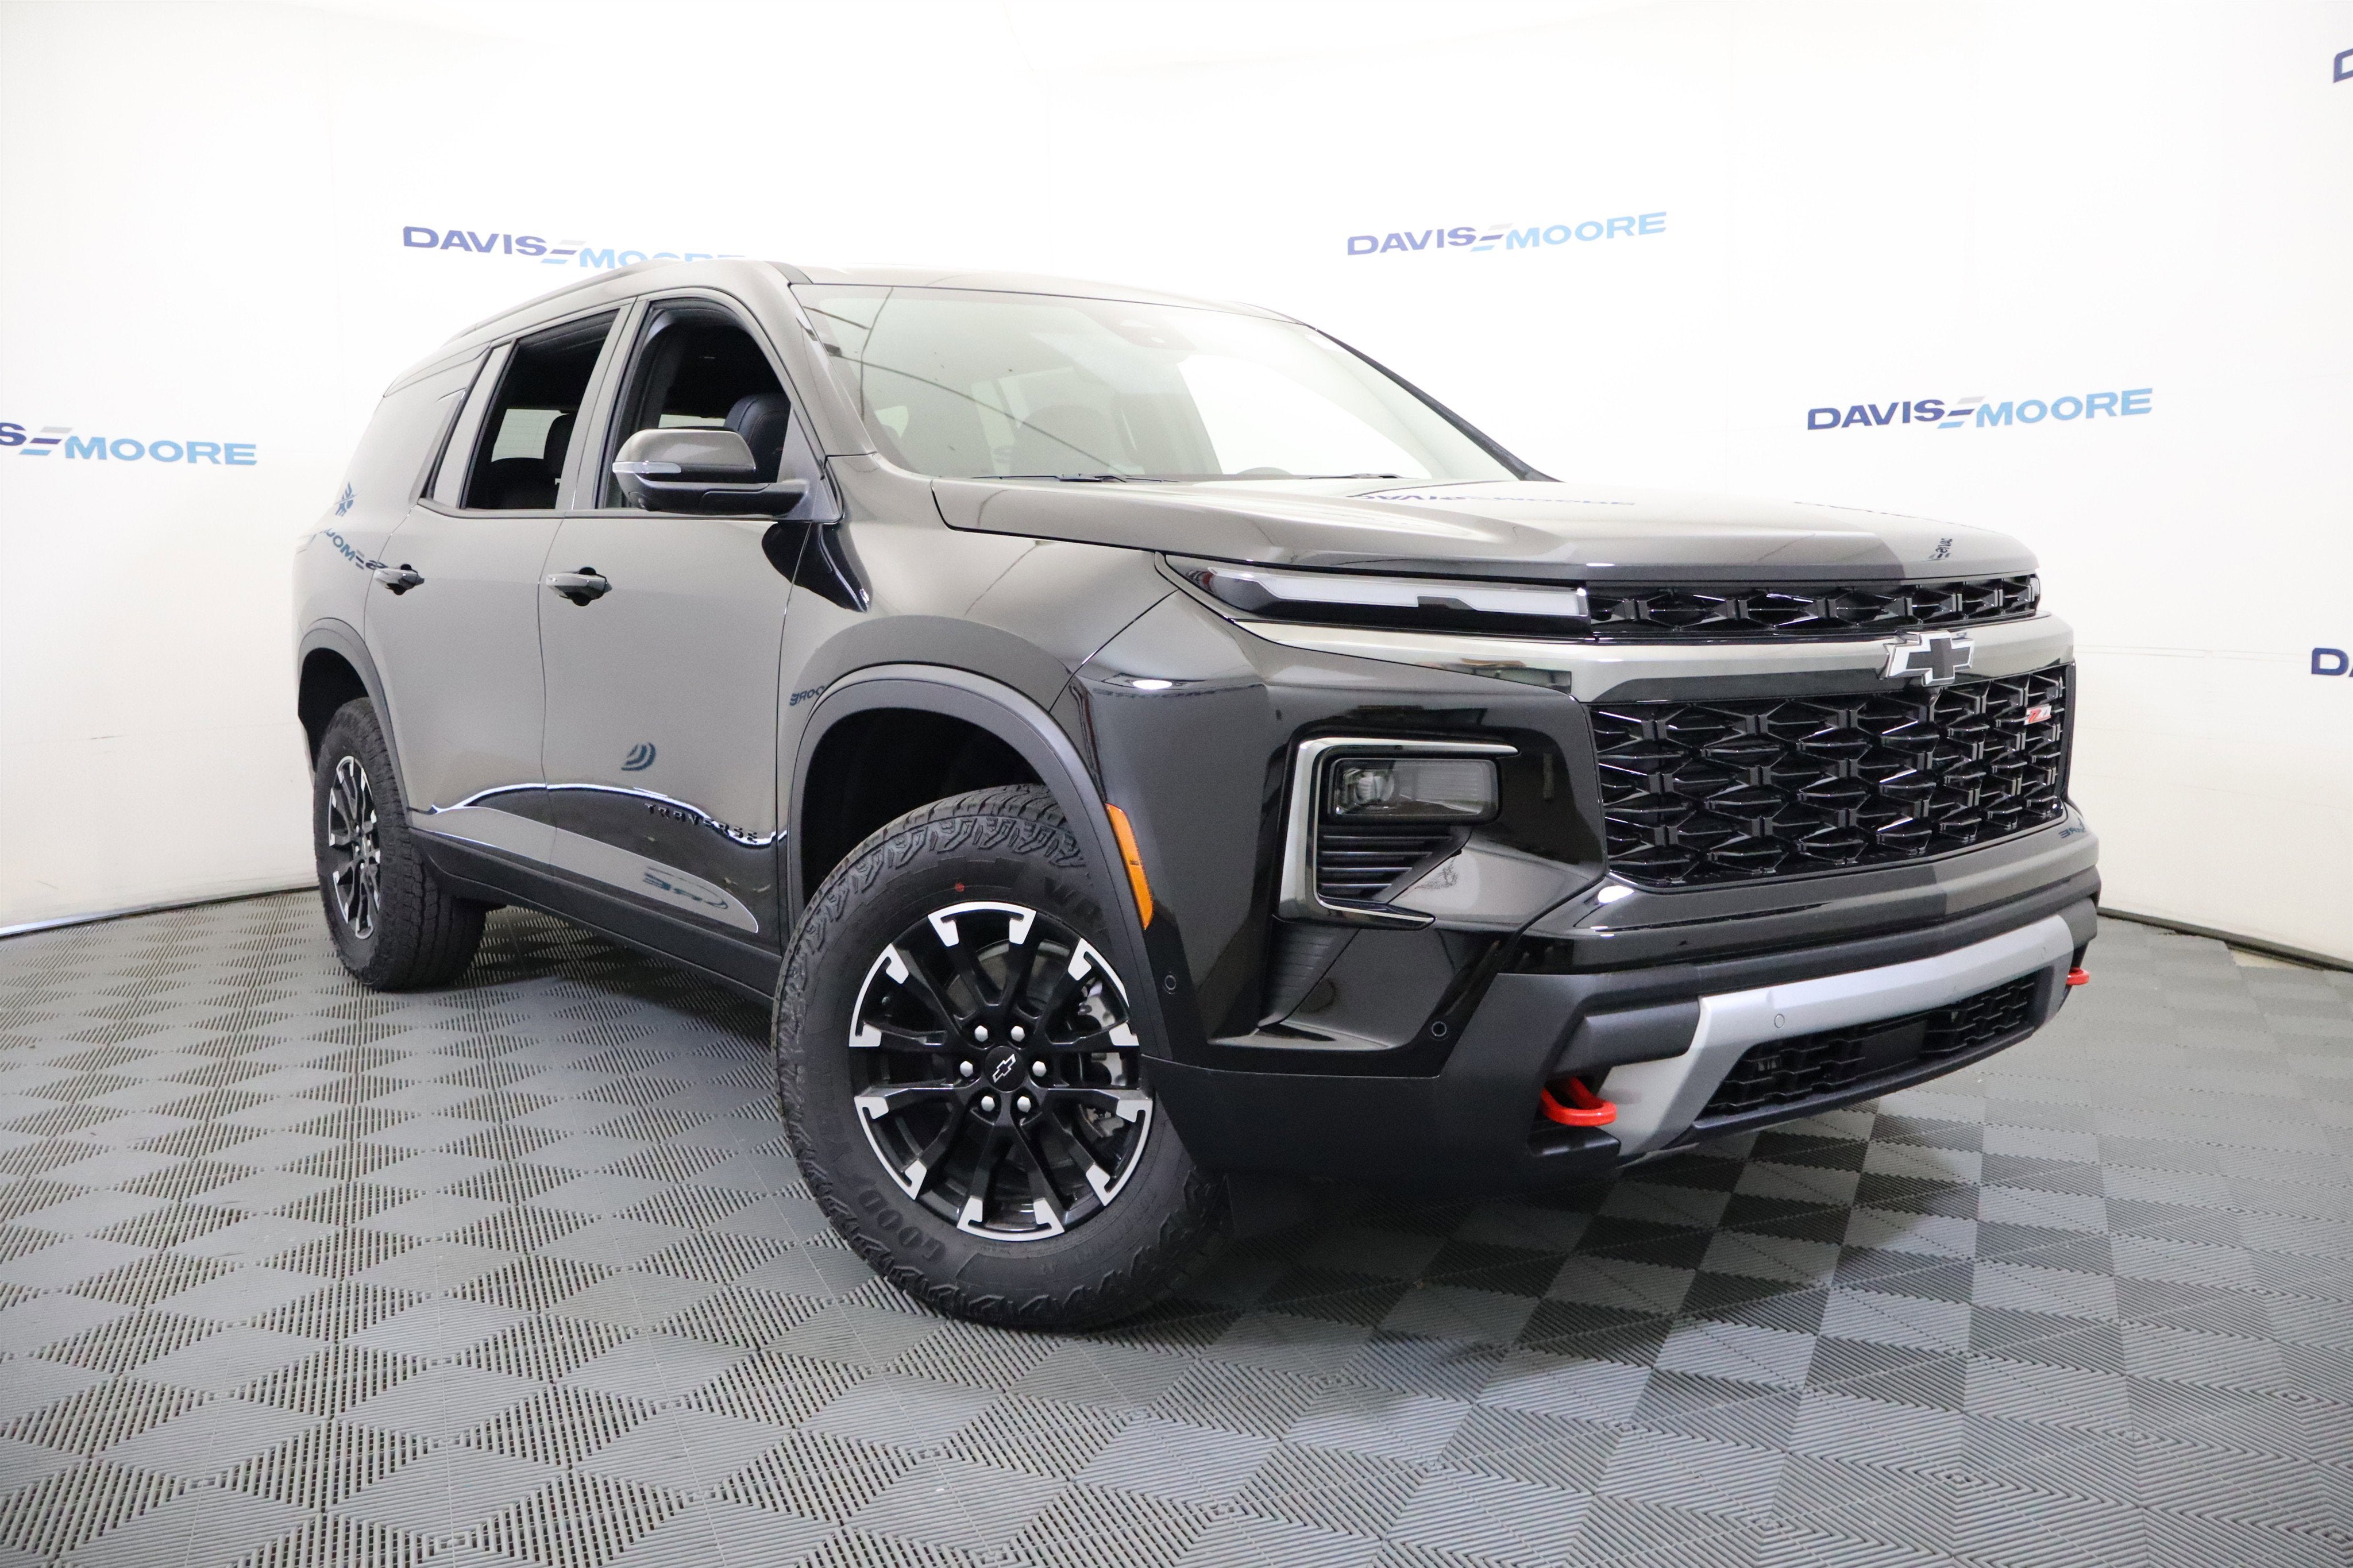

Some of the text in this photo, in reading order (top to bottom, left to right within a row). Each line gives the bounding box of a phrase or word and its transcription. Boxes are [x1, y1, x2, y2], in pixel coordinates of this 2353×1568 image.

[403, 226, 548, 256] DAVIS
[1347, 211, 1667, 255] DAVIS MOORE
[1807, 388, 2153, 430] DAVIS MOORE
[64, 435, 257, 466] MOORE
[643, 802, 758, 844] TRAVERSE
